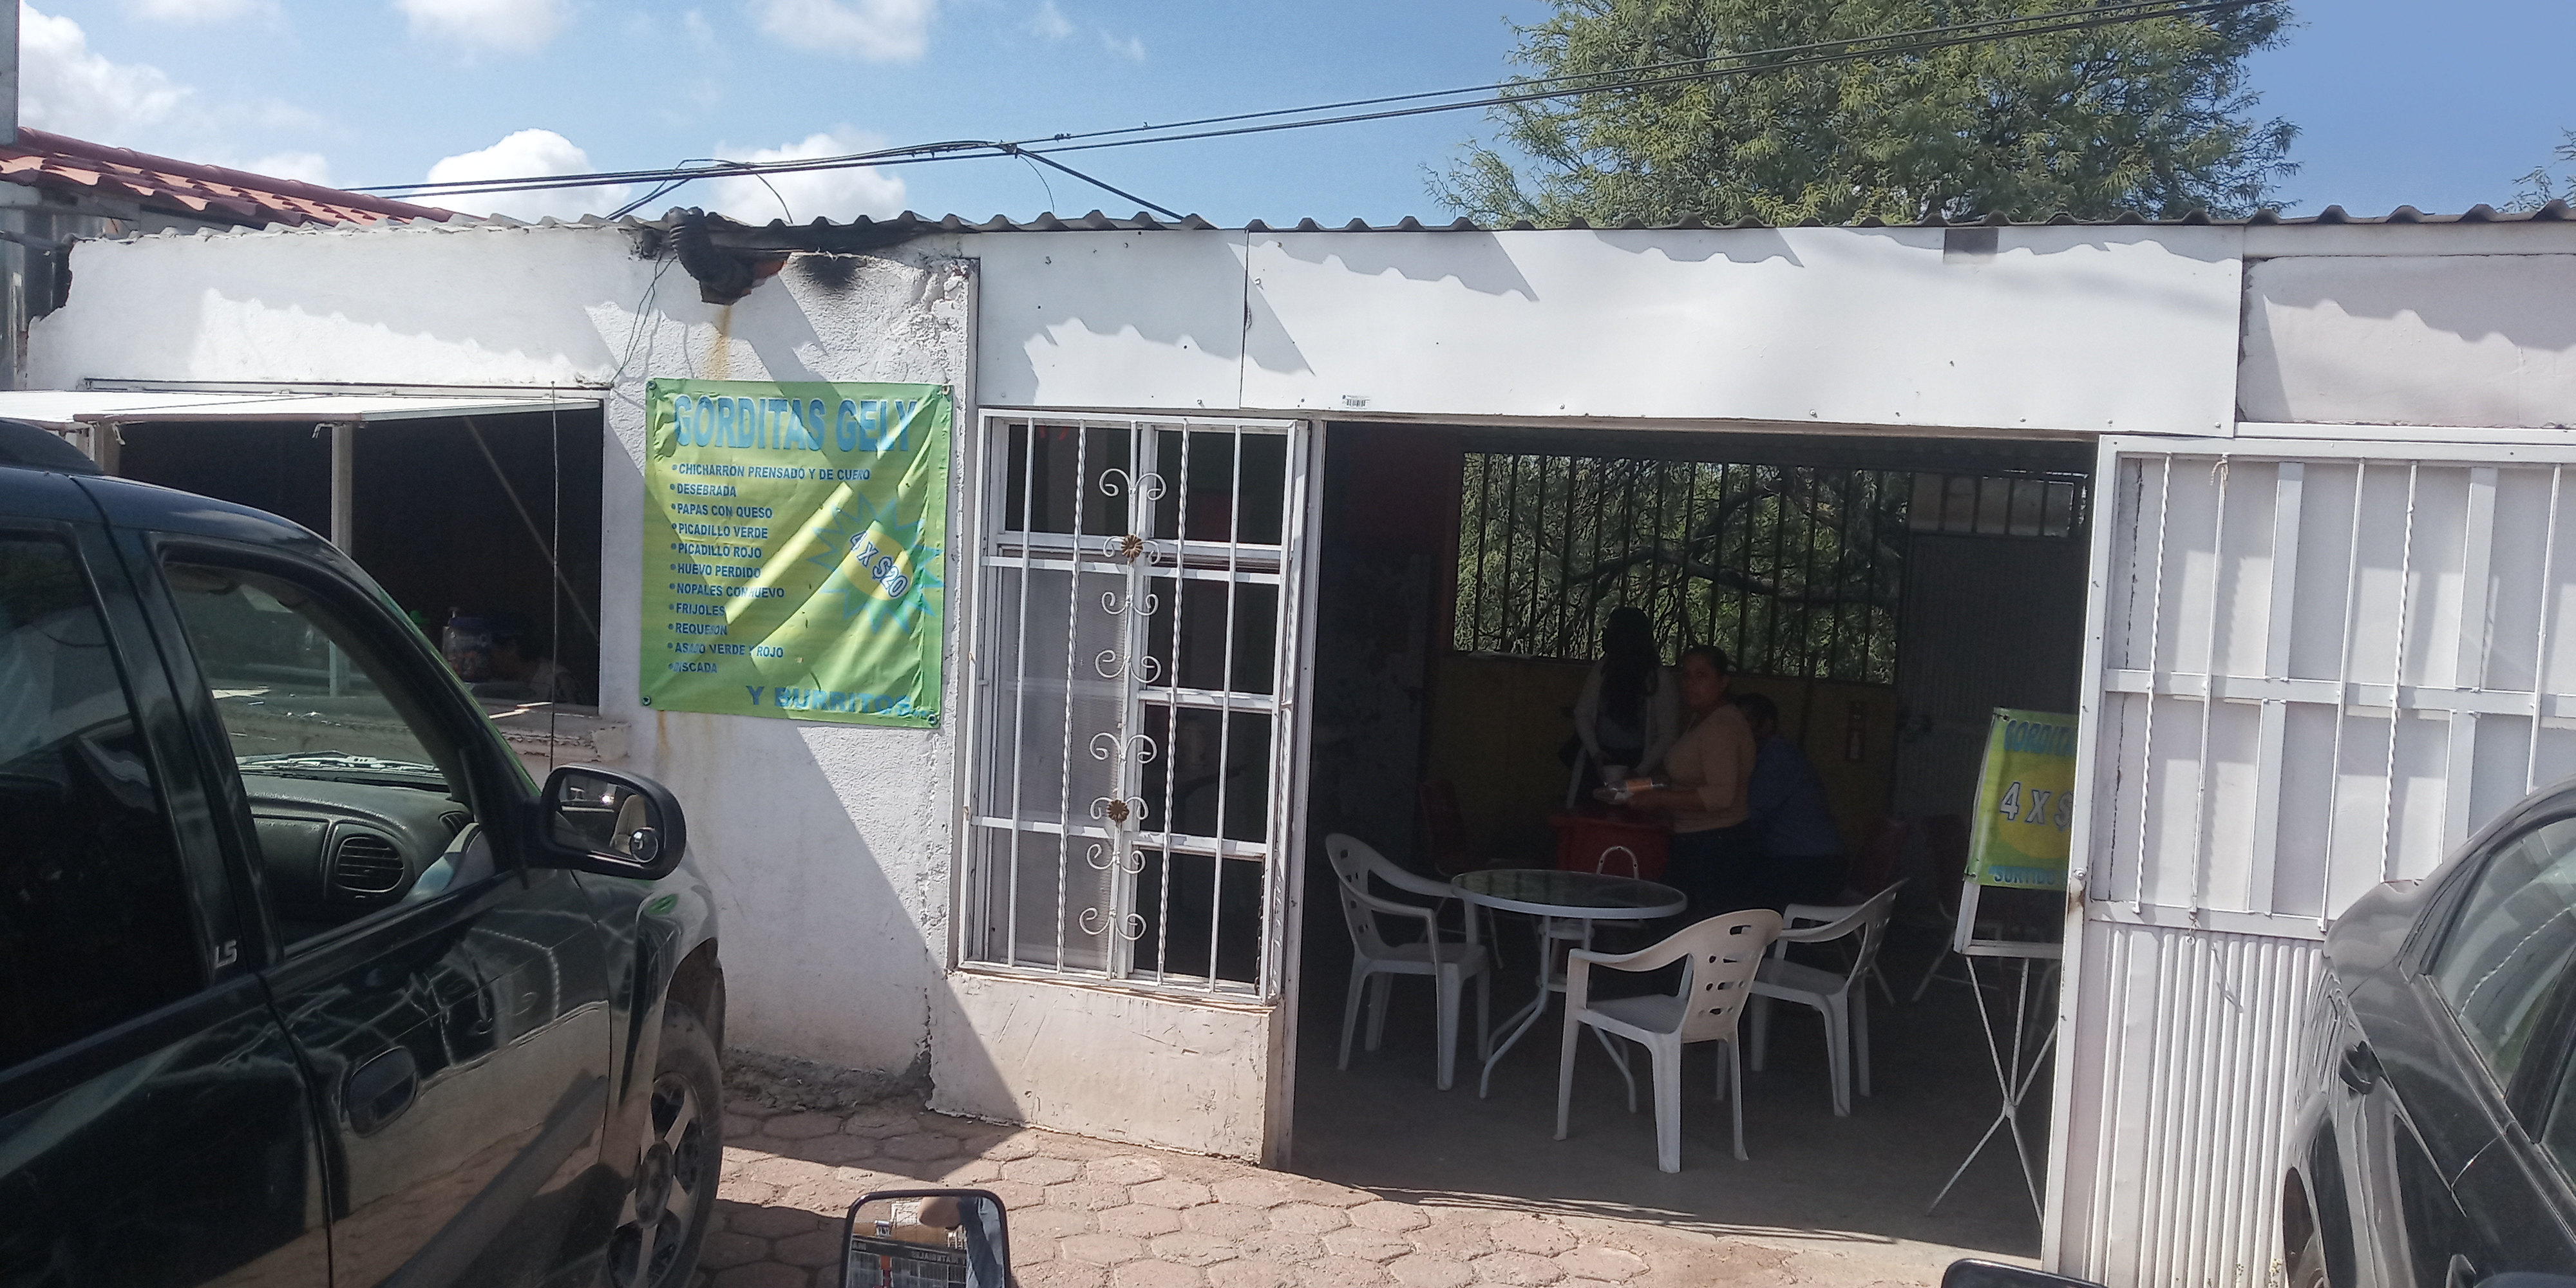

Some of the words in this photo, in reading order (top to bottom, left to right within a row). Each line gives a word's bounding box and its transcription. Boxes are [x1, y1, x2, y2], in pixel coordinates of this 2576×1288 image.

[674, 394, 826, 451] GORDITAS
[836, 399, 918, 452] GELY
[679, 464, 744, 477] CHICHARRON
[748, 466, 805, 479] PRENSADO
[809, 468, 816, 479] Y
[819, 469, 833, 480] DE
[837, 469, 870, 480] CUERO
[677, 483, 737, 497] DESEBRADA
[677, 503, 708, 515] PAPAS
[711, 506, 733, 517] CON
[736, 507, 773, 518] QUESO
[678, 522, 730, 536] PICADILLO
[734, 526, 768, 539] VERDE
[849, 531, 867, 551] 4
[678, 543, 730, 556] PICADILLO
[734, 546, 762, 558] ROJO
[857, 542, 879, 567] X
[677, 563, 712, 576] HUEVO
[715, 565, 761, 578] PERDIDO
[872, 556, 909, 598] $20
[677, 583, 723, 596] NOPALES
[726, 586, 747, 598] CON
[748, 587, 784, 598] HUEVO
[676, 603, 725, 616] FRIJOLES
[676, 623, 728, 635] REQUESON
[675, 643, 705, 654] ASADO
[709, 644, 745, 656] VERDE
[757, 647, 784, 658] ROJO
[673, 661, 717, 673] DISCADA
[746, 685, 765, 705] Y
[2000, 781, 2021, 821] 4
[2025, 789, 2052, 825] X
[214, 940, 238, 969] LS
